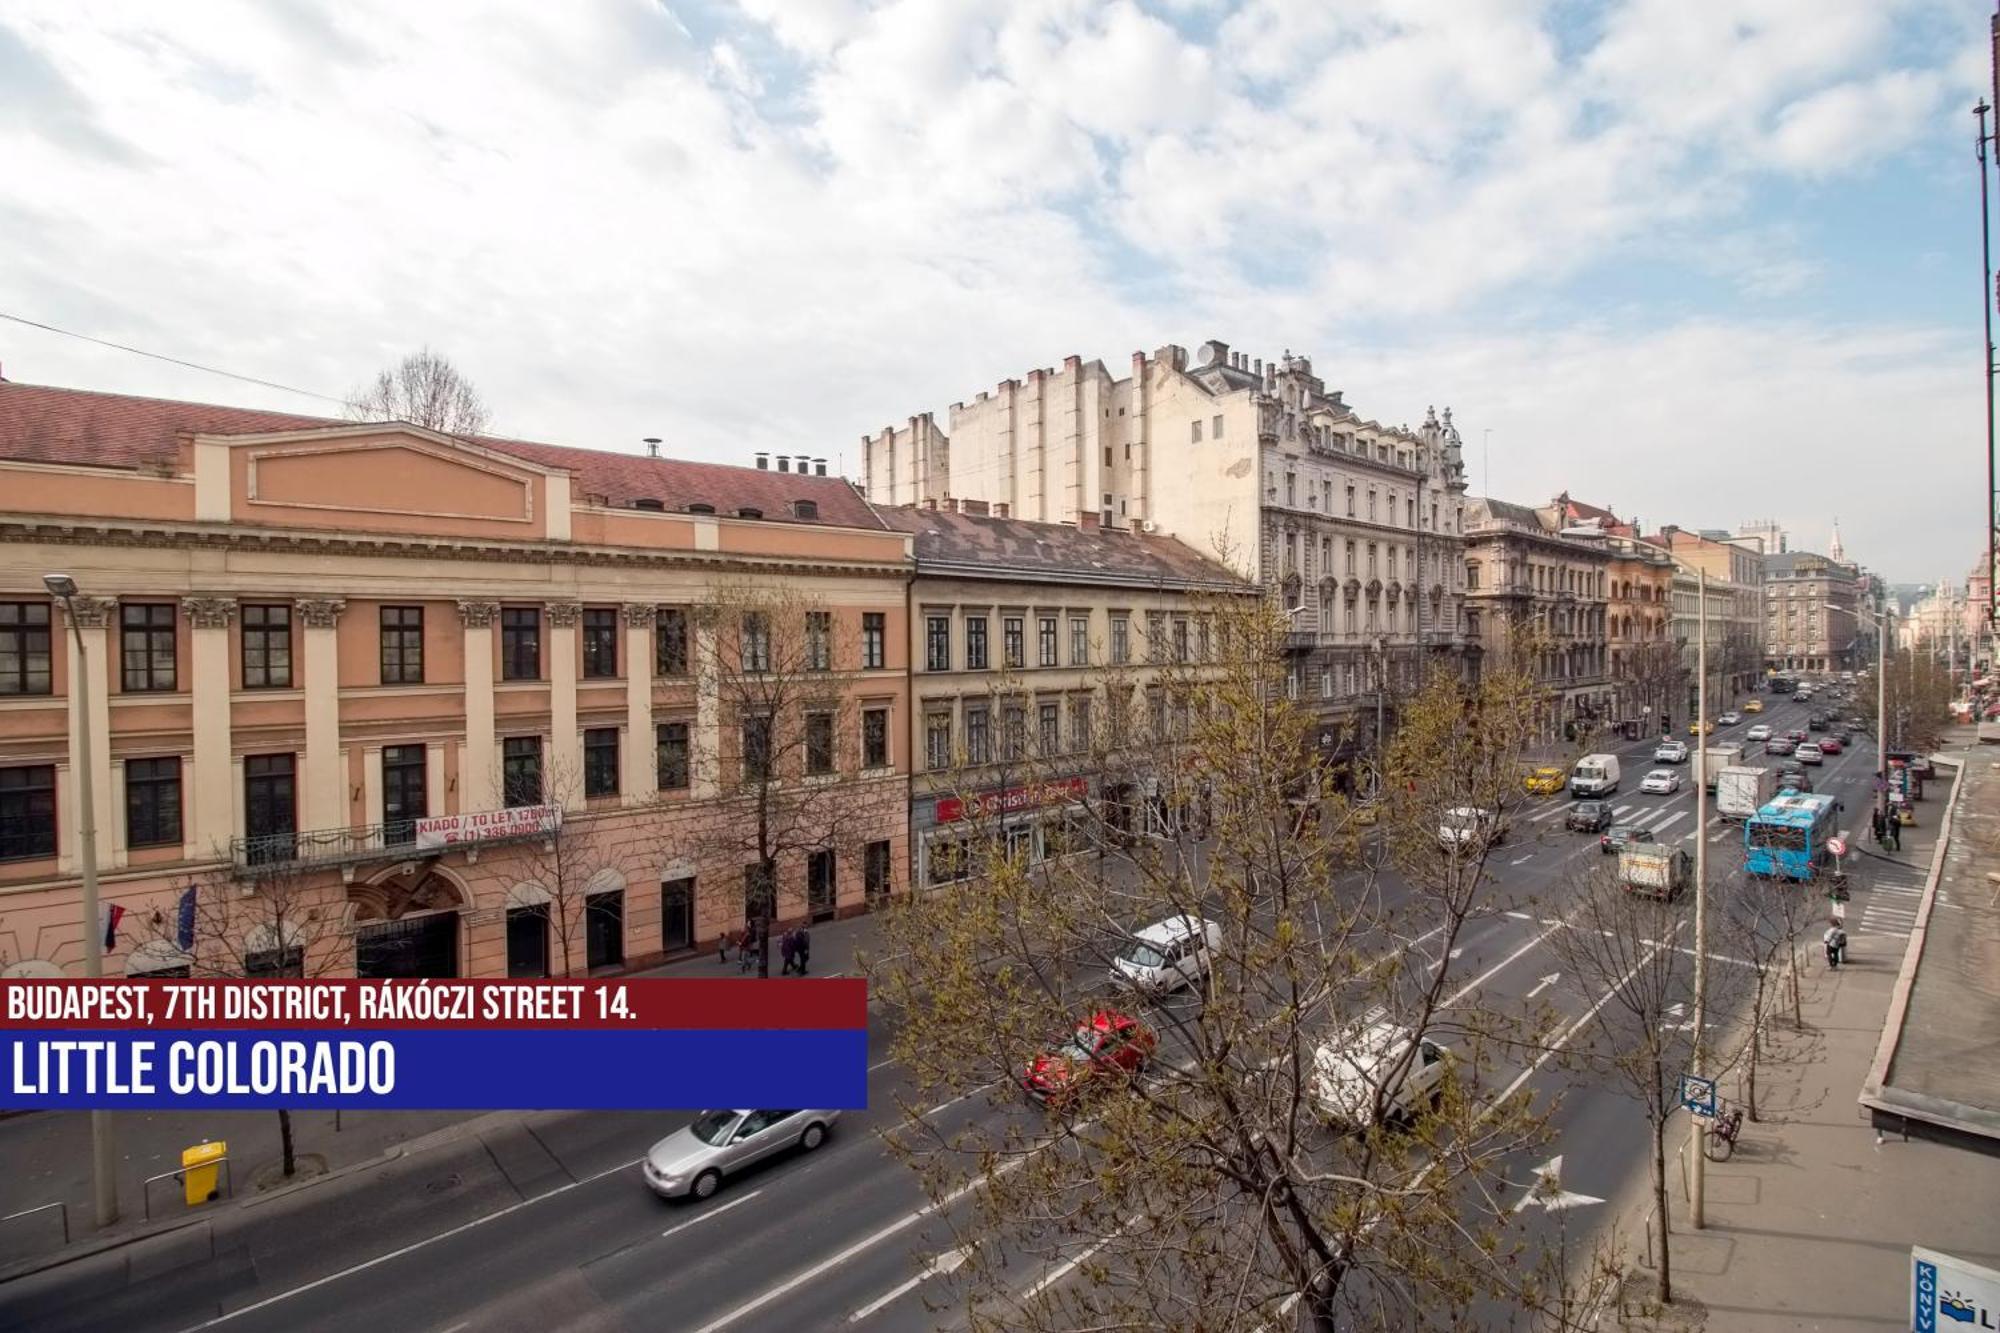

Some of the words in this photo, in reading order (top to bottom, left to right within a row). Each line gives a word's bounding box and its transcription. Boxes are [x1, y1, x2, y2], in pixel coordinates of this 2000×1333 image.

[472, 814, 487, 826] TO
[492, 811, 512, 824] LET
[464, 828, 480, 841] (1)
